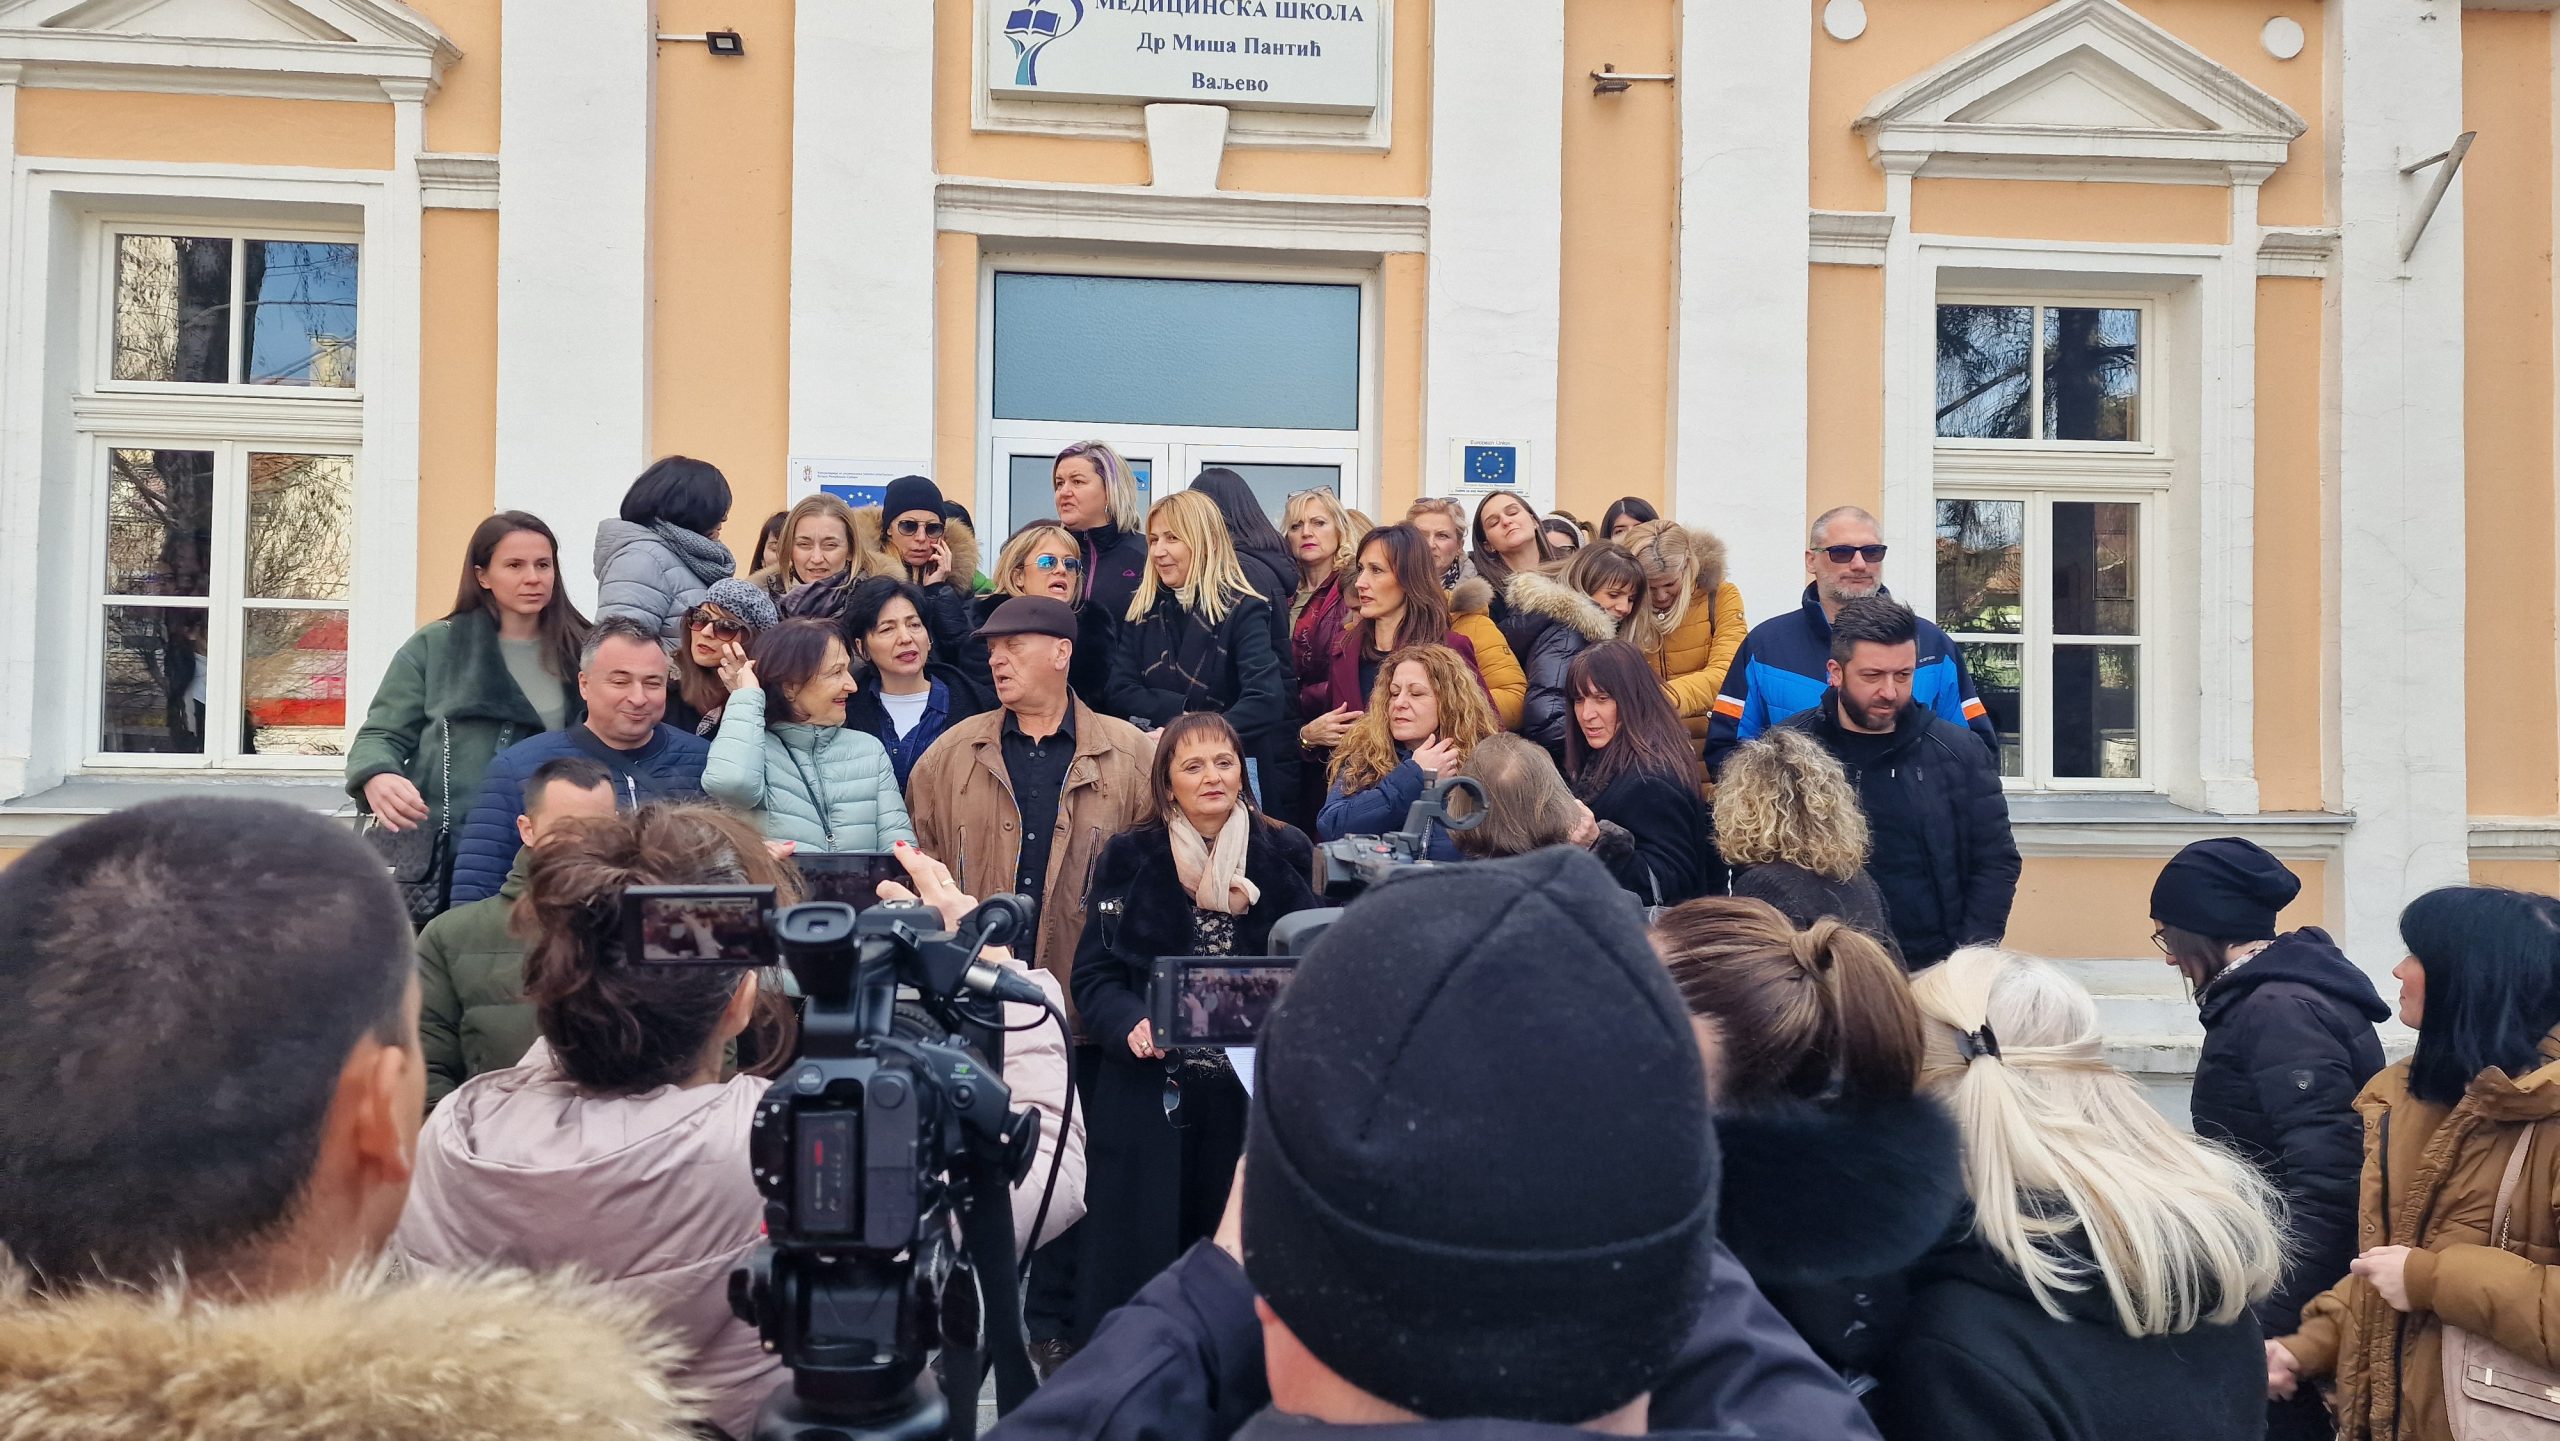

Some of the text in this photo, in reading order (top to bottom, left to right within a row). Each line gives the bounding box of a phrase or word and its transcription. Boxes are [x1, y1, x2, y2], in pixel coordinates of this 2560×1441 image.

[1096, 0, 1363, 21] МЕДИЦИНСКА ШКОЛА
[1136, 32, 1321, 57] Др Миша Пантић
[1191, 71, 1269, 92] Ваљево
